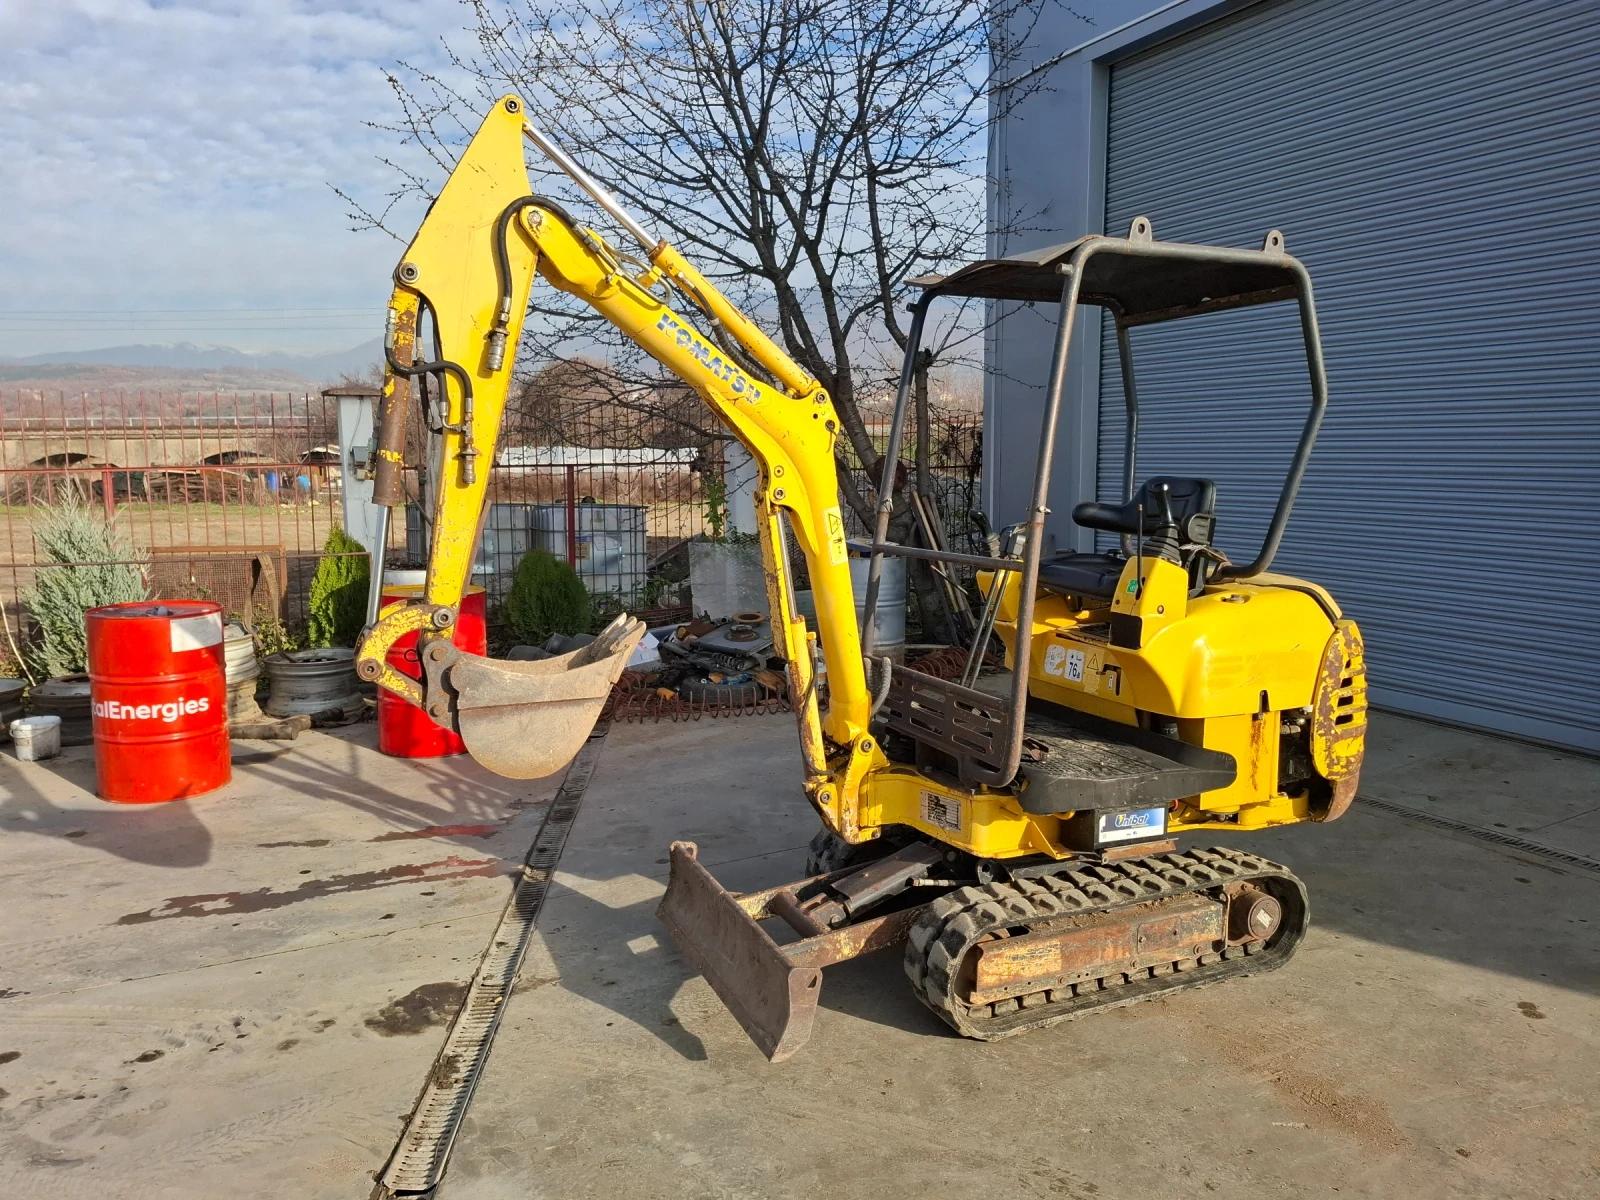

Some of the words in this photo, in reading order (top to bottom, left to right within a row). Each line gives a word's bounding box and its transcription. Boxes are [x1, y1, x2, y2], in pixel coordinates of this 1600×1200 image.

[656, 313, 761, 404] KOMATSU
[1069, 661, 1078, 677] 76
[1115, 813, 1150, 827] Unibat
